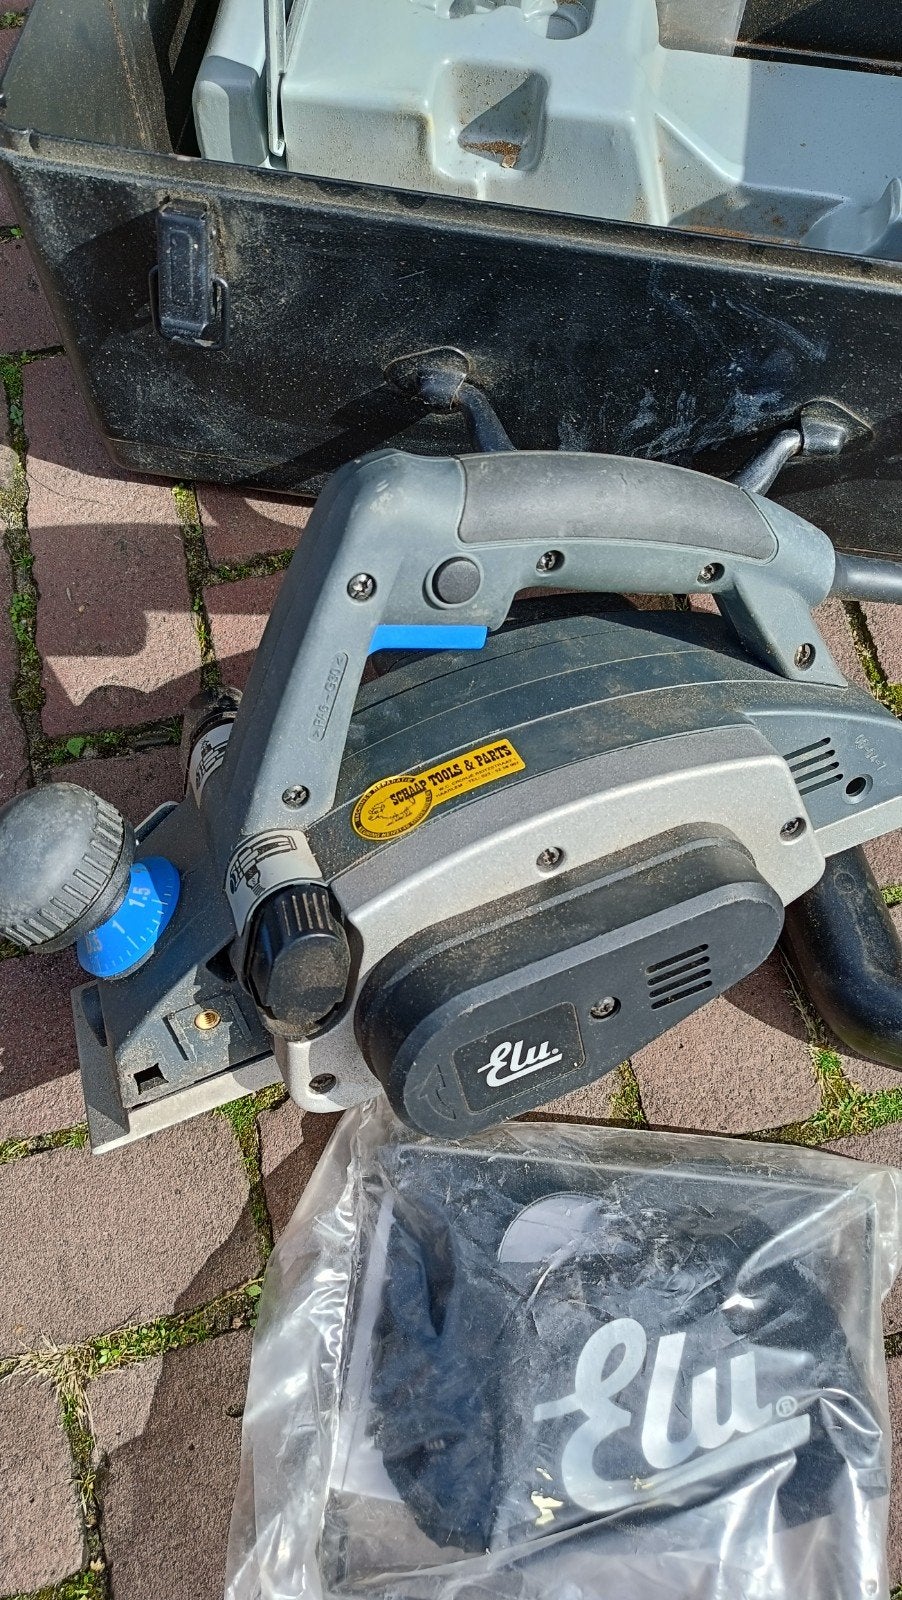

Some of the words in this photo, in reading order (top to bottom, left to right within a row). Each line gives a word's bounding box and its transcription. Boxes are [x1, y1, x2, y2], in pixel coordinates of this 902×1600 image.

[389, 779, 427, 806] SCHAAP
[427, 763, 463, 787] TOOLS
[463, 759, 475, 771] &
[473, 744, 512, 767] PARTS
[128, 886, 152, 908] 1.5
[112, 920, 126, 934] 1
